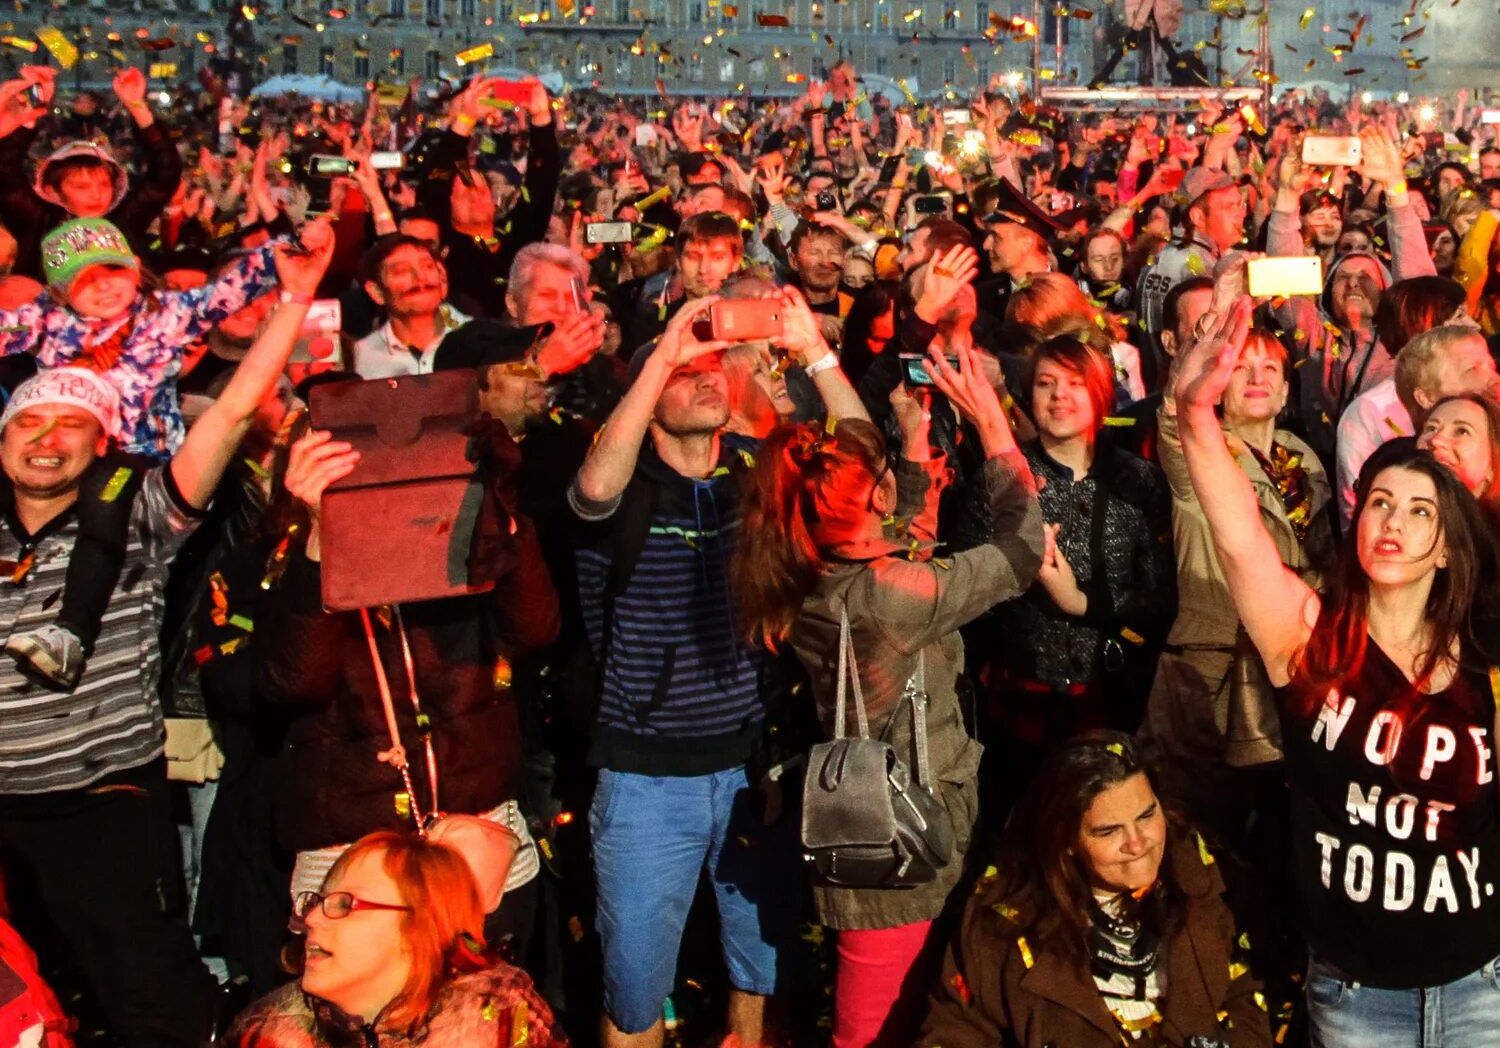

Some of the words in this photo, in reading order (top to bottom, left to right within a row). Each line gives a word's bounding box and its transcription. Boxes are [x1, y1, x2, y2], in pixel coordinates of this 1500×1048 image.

[1311, 687, 1493, 785] NOPE
[1345, 782, 1456, 842] NOT
[1315, 832, 1495, 914] TODAY.
